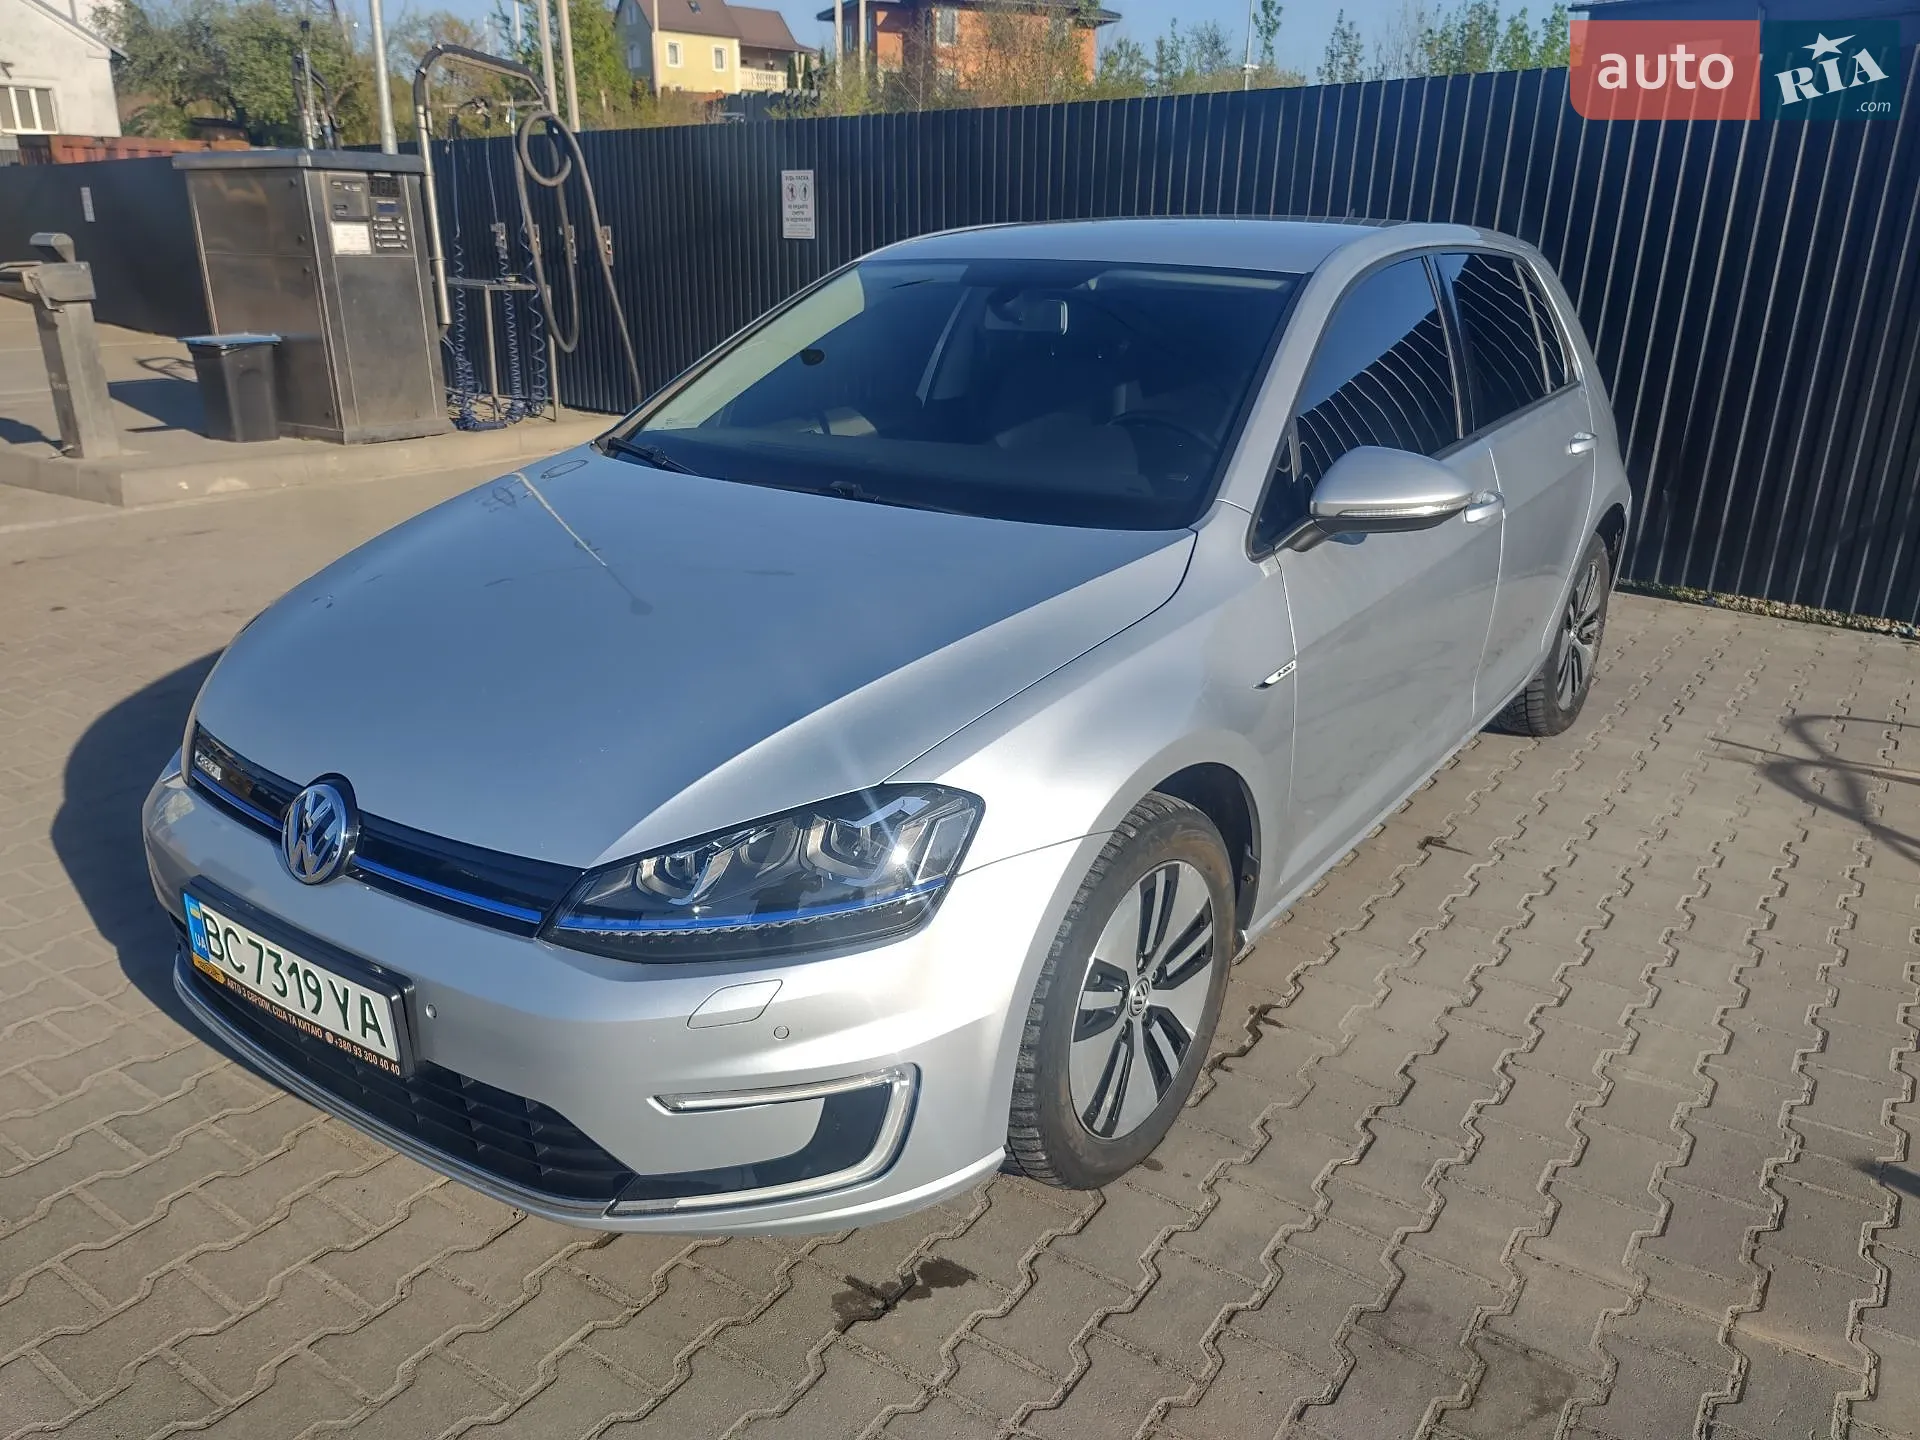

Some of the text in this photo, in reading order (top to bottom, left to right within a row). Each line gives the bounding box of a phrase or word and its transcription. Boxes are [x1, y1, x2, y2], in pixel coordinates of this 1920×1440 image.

[195, 932, 208, 950] UA
[273, 1006, 288, 1023] США
[353, 1045, 363, 1058] 93
[380, 1058, 389, 1071] 40
[391, 1063, 401, 1076] 40
